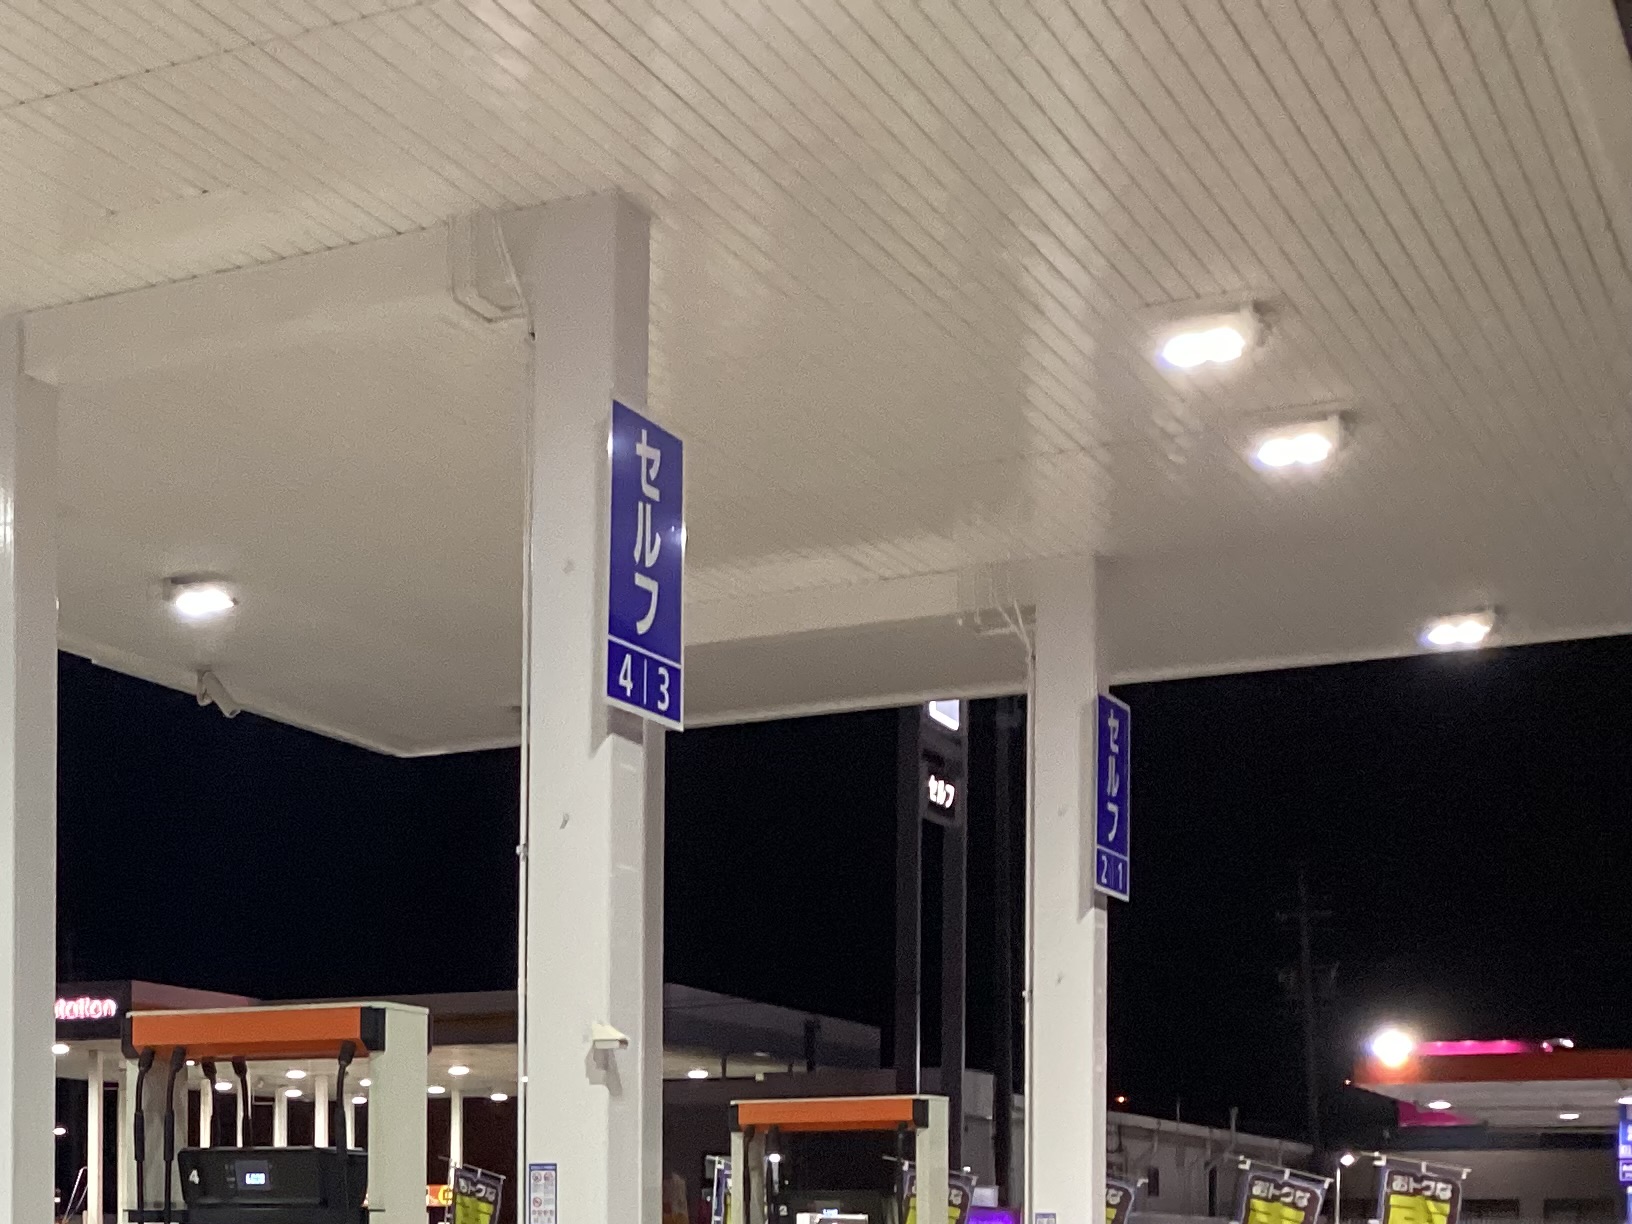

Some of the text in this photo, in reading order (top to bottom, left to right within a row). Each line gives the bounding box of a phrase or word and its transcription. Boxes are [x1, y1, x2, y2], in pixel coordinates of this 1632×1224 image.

[633, 429, 661, 636] セルフ
[619, 653, 670, 712] 4 3
[1107, 709, 1120, 842] セルフ
[1101, 855, 1123, 890] 2 1
[188, 1169, 200, 1185] 4
